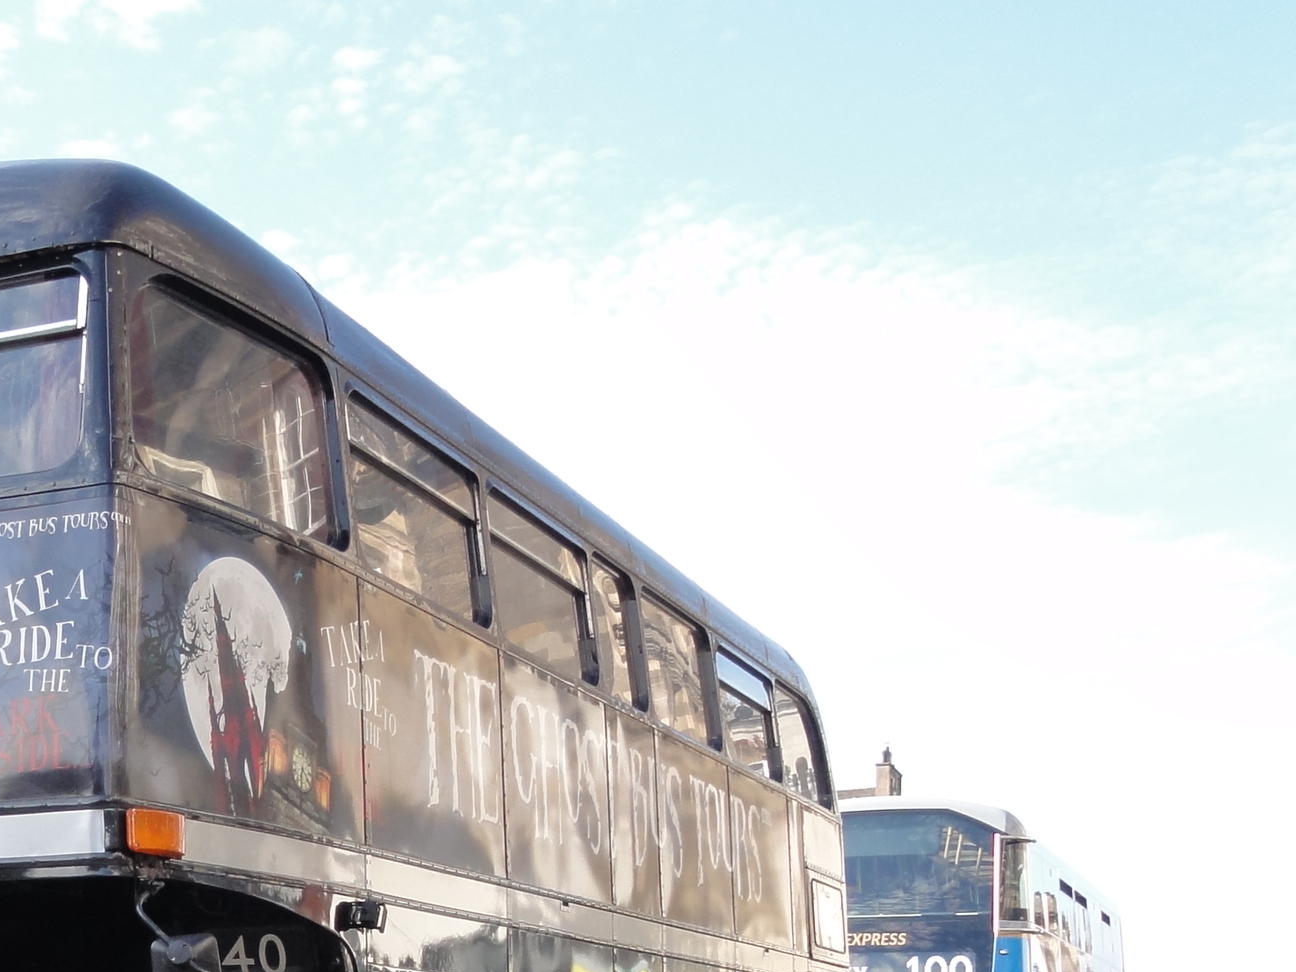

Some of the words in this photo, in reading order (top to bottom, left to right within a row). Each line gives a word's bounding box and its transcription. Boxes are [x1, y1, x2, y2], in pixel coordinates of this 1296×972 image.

[29, 516, 58, 537] BUS
[65, 569, 88, 600] A
[76, 644, 113, 670] TO
[320, 620, 374, 667] TAKE
[23, 668, 71, 693] THE
[346, 667, 382, 718] RIDE
[382, 705, 397, 736] TO
[414, 649, 500, 824] THE
[511, 696, 620, 858] GHOST
[630, 748, 683, 878] BUS
[689, 774, 763, 903] TOURS
[847, 932, 907, 946] EXPRESS
